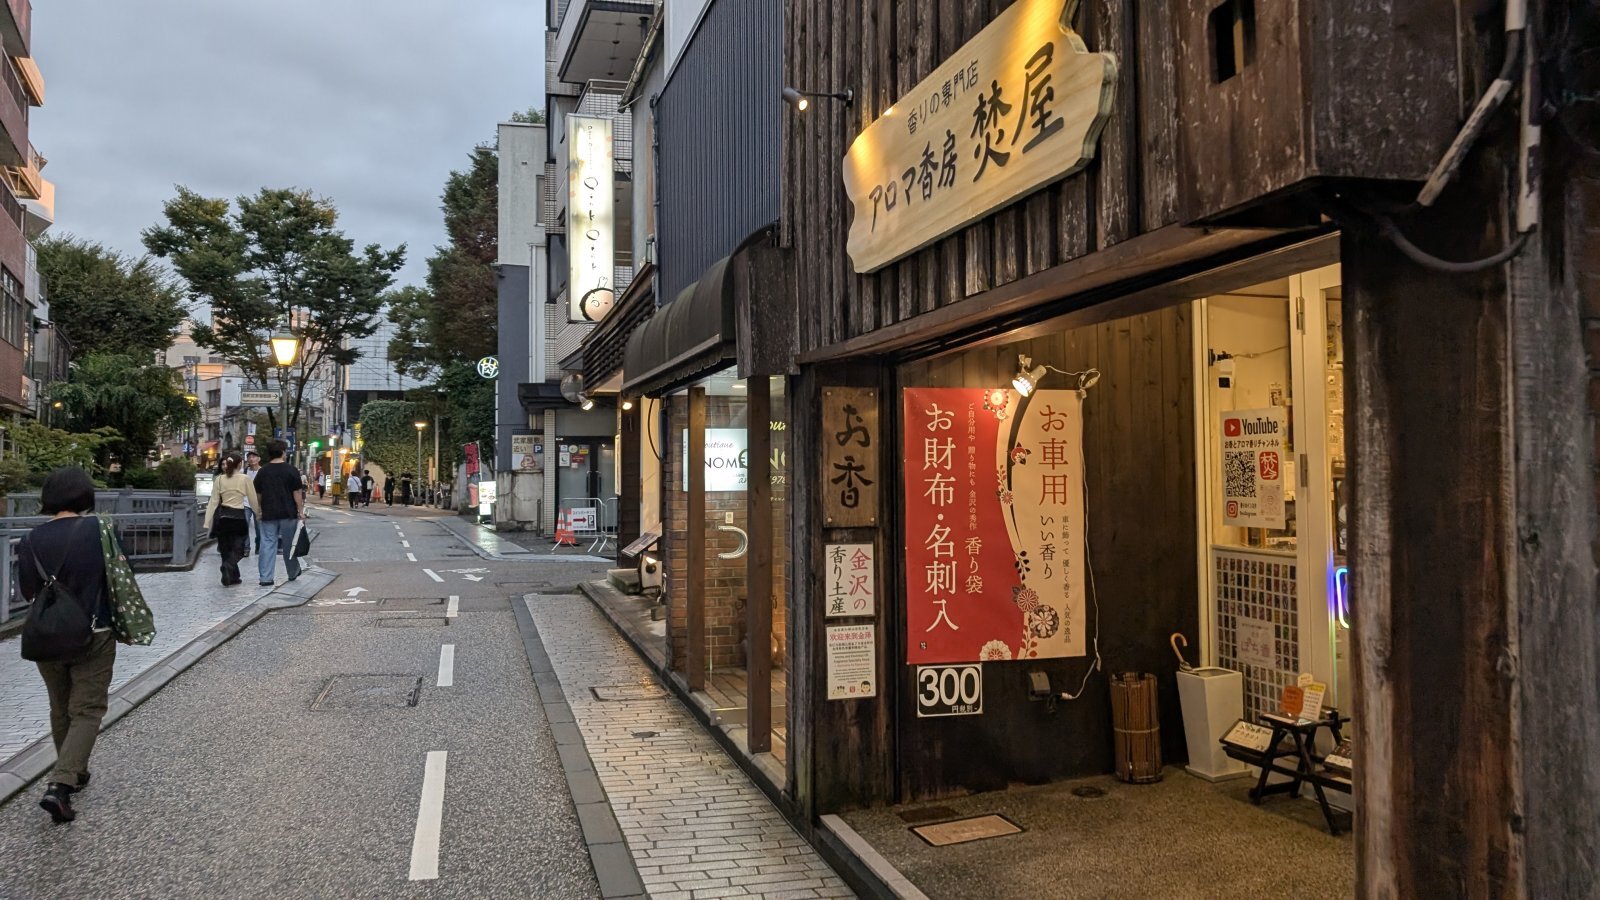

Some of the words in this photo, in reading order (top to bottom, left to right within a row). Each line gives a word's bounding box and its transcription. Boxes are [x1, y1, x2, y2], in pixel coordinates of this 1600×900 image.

[907, 58, 979, 135] 香りの専門店
[868, 129, 958, 233] アロマ香房
[969, 41, 1064, 183] 焚屋
[830, 403, 875, 509] お香
[1037, 403, 1069, 507] お車用
[1241, 416, 1279, 436] YouTube
[922, 402, 959, 633] お財布・名刺入
[1039, 515, 1056, 580] いい香り
[828, 545, 847, 615] 香り土産
[848, 546, 873, 611] 金沢の
[965, 536, 983, 594] 香り袋
[919, 667, 980, 707] 300
